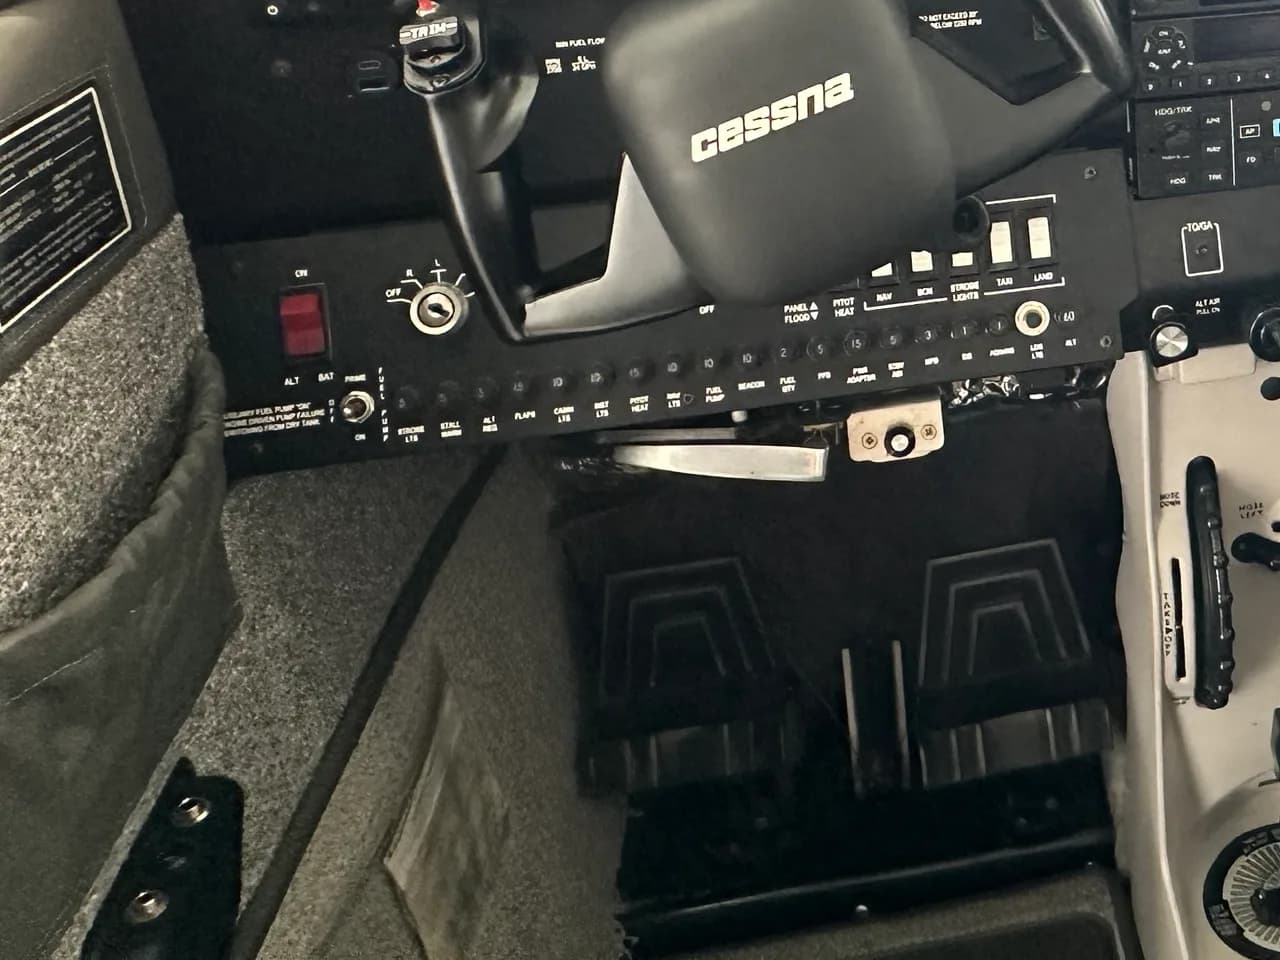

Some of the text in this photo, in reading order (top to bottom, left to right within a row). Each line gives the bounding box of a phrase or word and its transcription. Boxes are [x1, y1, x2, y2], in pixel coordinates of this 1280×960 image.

[410, 22, 447, 39] TRIM
[691, 72, 855, 164] cessna
[1186, 220, 1214, 233] TO/GA
[434, 258, 441, 267] L
[406, 268, 414, 277] R
[1033, 271, 1054, 283] LAND
[996, 276, 1014, 288] TAXI
[385, 287, 402, 298] OFF
[952, 291, 980, 303] LIGHTS
[832, 296, 856, 308] PITOT
[699, 304, 716, 315] OFF
[783, 302, 810, 314] PANEL
[834, 307, 856, 319] HEAT
[784, 312, 812, 324] FLOOD
[816, 343, 824, 355] 5
[851, 338, 863, 349] 15
[780, 347, 788, 358] 2
[704, 358, 714, 368] 10
[742, 353, 753, 364] 10
[284, 376, 300, 386] ALT
[318, 372, 335, 383] BAT
[779, 376, 797, 385] FUEL
[705, 386, 723, 395] FUEL
[705, 393, 726, 403] PUMP
[631, 403, 649, 413] HEAT
[297, 408, 326, 420] FAILURE
[514, 409, 537, 421] FLAPS
[354, 433, 366, 441] ON
